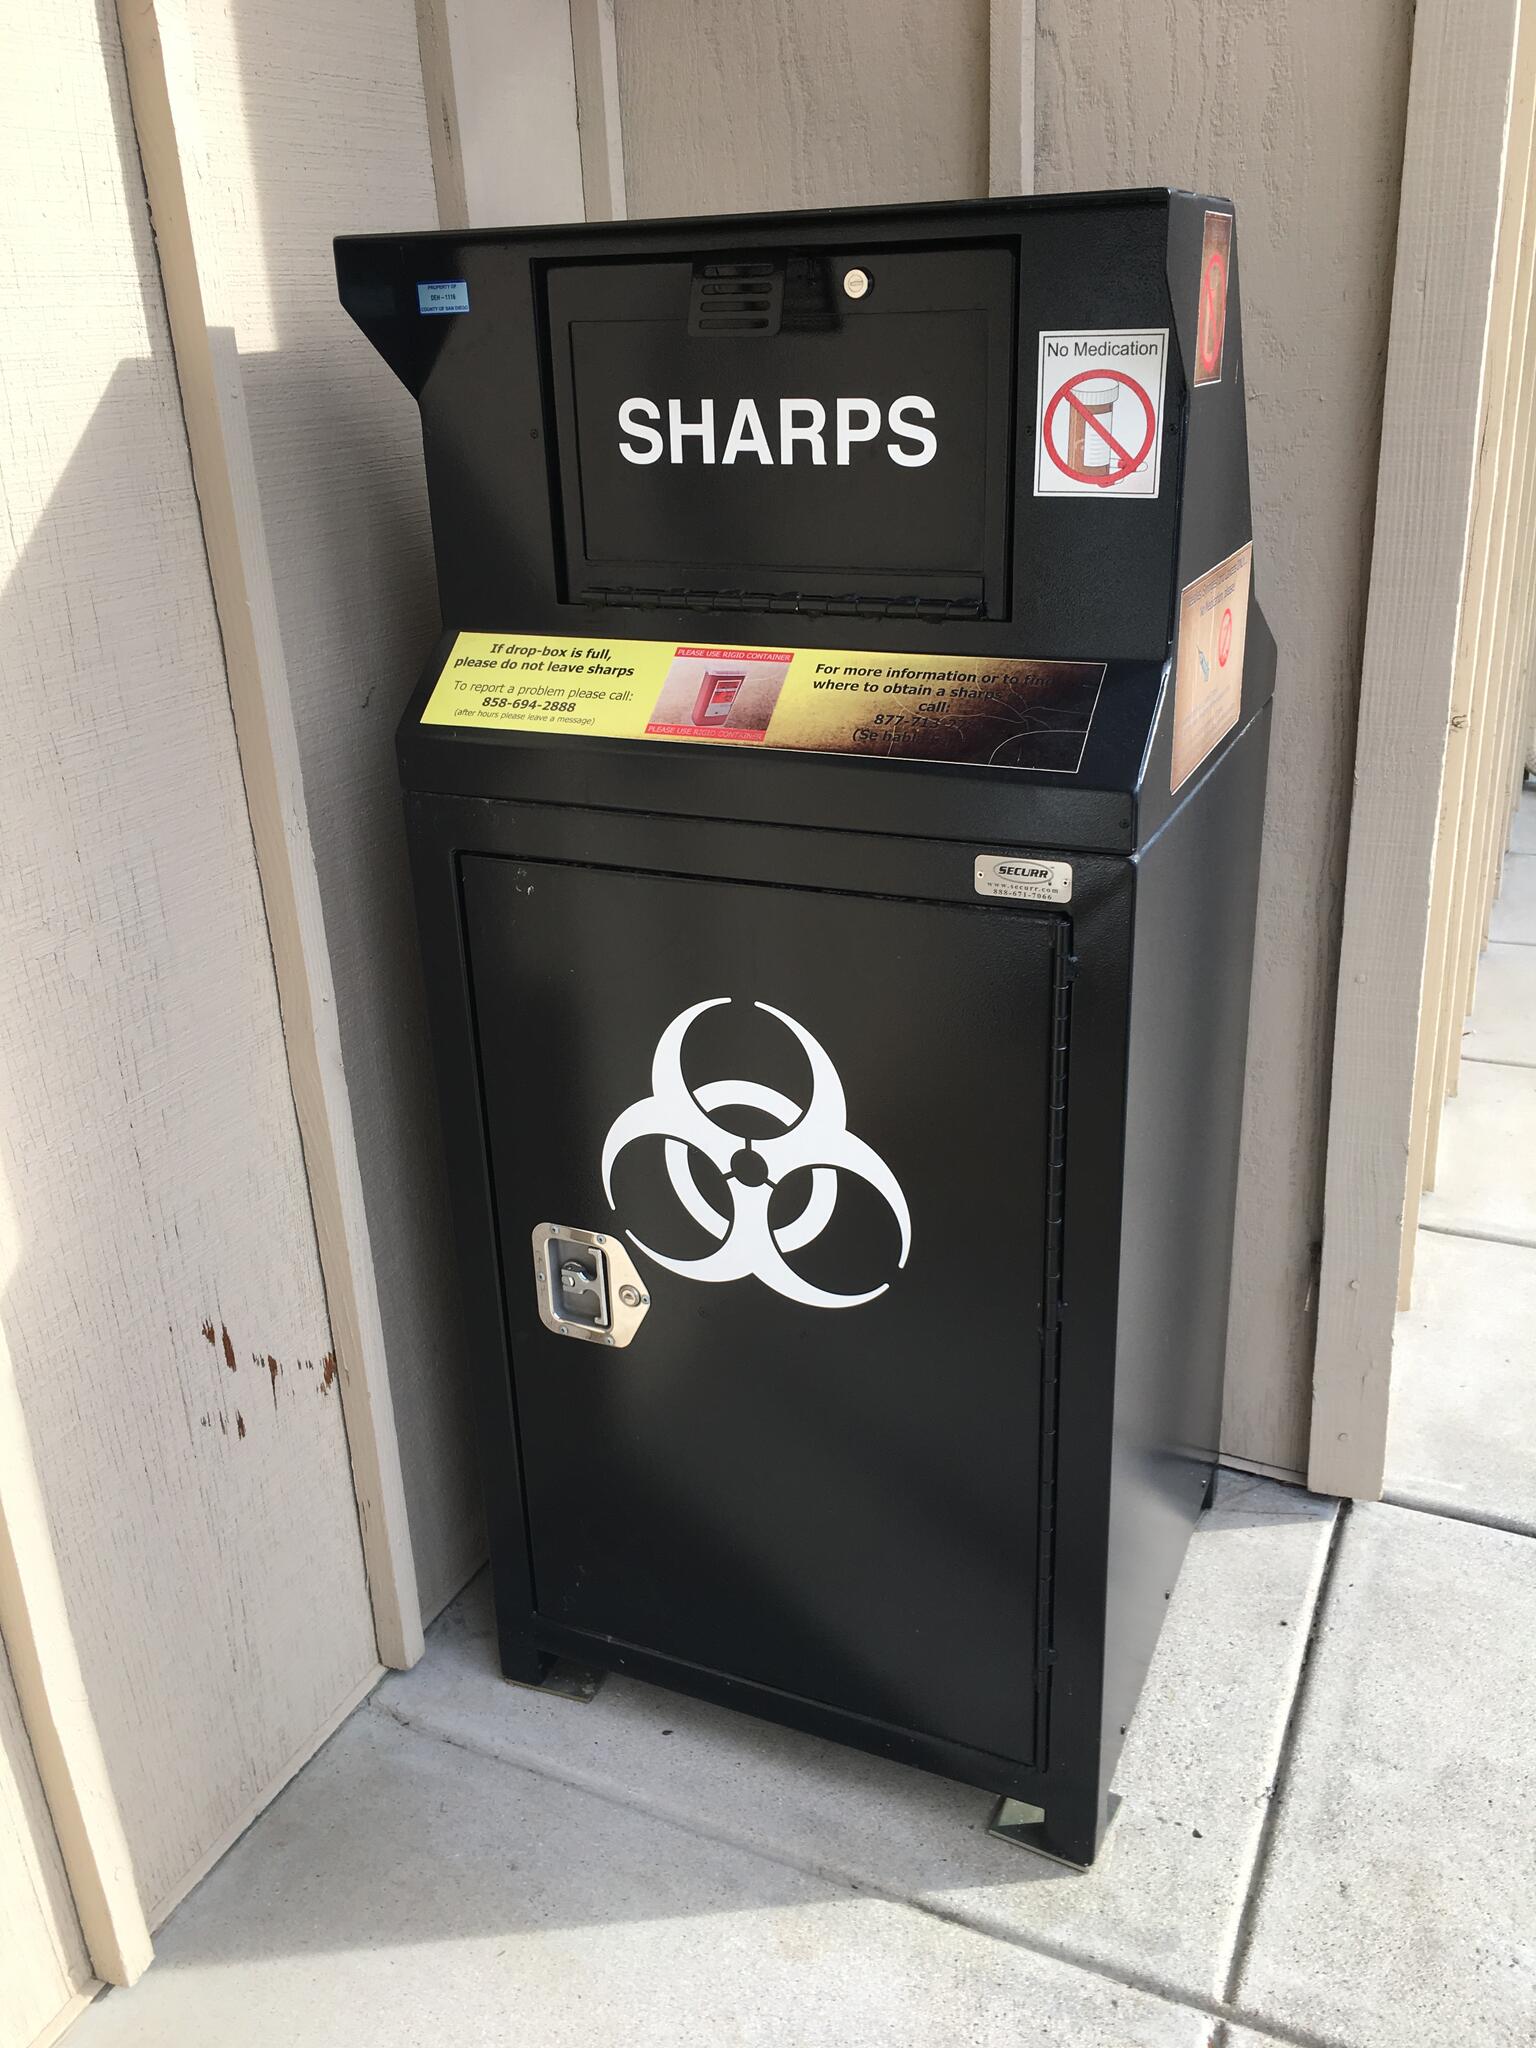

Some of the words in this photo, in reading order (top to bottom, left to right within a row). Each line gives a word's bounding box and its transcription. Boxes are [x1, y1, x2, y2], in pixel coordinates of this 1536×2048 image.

[1047, 342, 1069, 357] No
[1074, 341, 1158, 357] Medication
[617, 395, 938, 467] SHARPS
[490, 644, 504, 654] If
[505, 644, 567, 658] drop-box
[570, 647, 582, 658] is
[585, 648, 612, 661] full,
[746, 653, 792, 661] CONTAINER
[453, 656, 497, 669] please
[500, 658, 517, 670] do
[521, 660, 544, 671] not
[547, 661, 584, 674] leave
[587, 663, 635, 678] sharps
[815, 663, 841, 675] For
[843, 666, 883, 677] more
[886, 667, 976, 684] information
[981, 674, 1000, 684] or
[1003, 674, 1019, 685] to
[453, 680, 467, 691] To
[469, 683, 505, 694] report
[507, 686, 515, 694] a
[517, 685, 565, 697] problem
[567, 687, 606, 700] please
[609, 690, 634, 701] call:
[813, 678, 859, 692] where
[863, 681, 879, 693] to
[883, 682, 931, 697] obtain
[936, 686, 946, 696] a
[482, 697, 576, 712] 858-694-2888
[918, 702, 951, 713] call:
[454, 708, 476, 717] (after
[477, 709, 499, 719] hours
[500, 711, 526, 721] please
[527, 712, 549, 722] leave
[556, 714, 596, 726] message)
[647, 724, 675, 733] PLEASE
[677, 726, 691, 734] USE
[693, 729, 716, 737] RIGID
[998, 866, 1049, 879] SECURR
[987, 882, 1058, 894] www.securr.com
